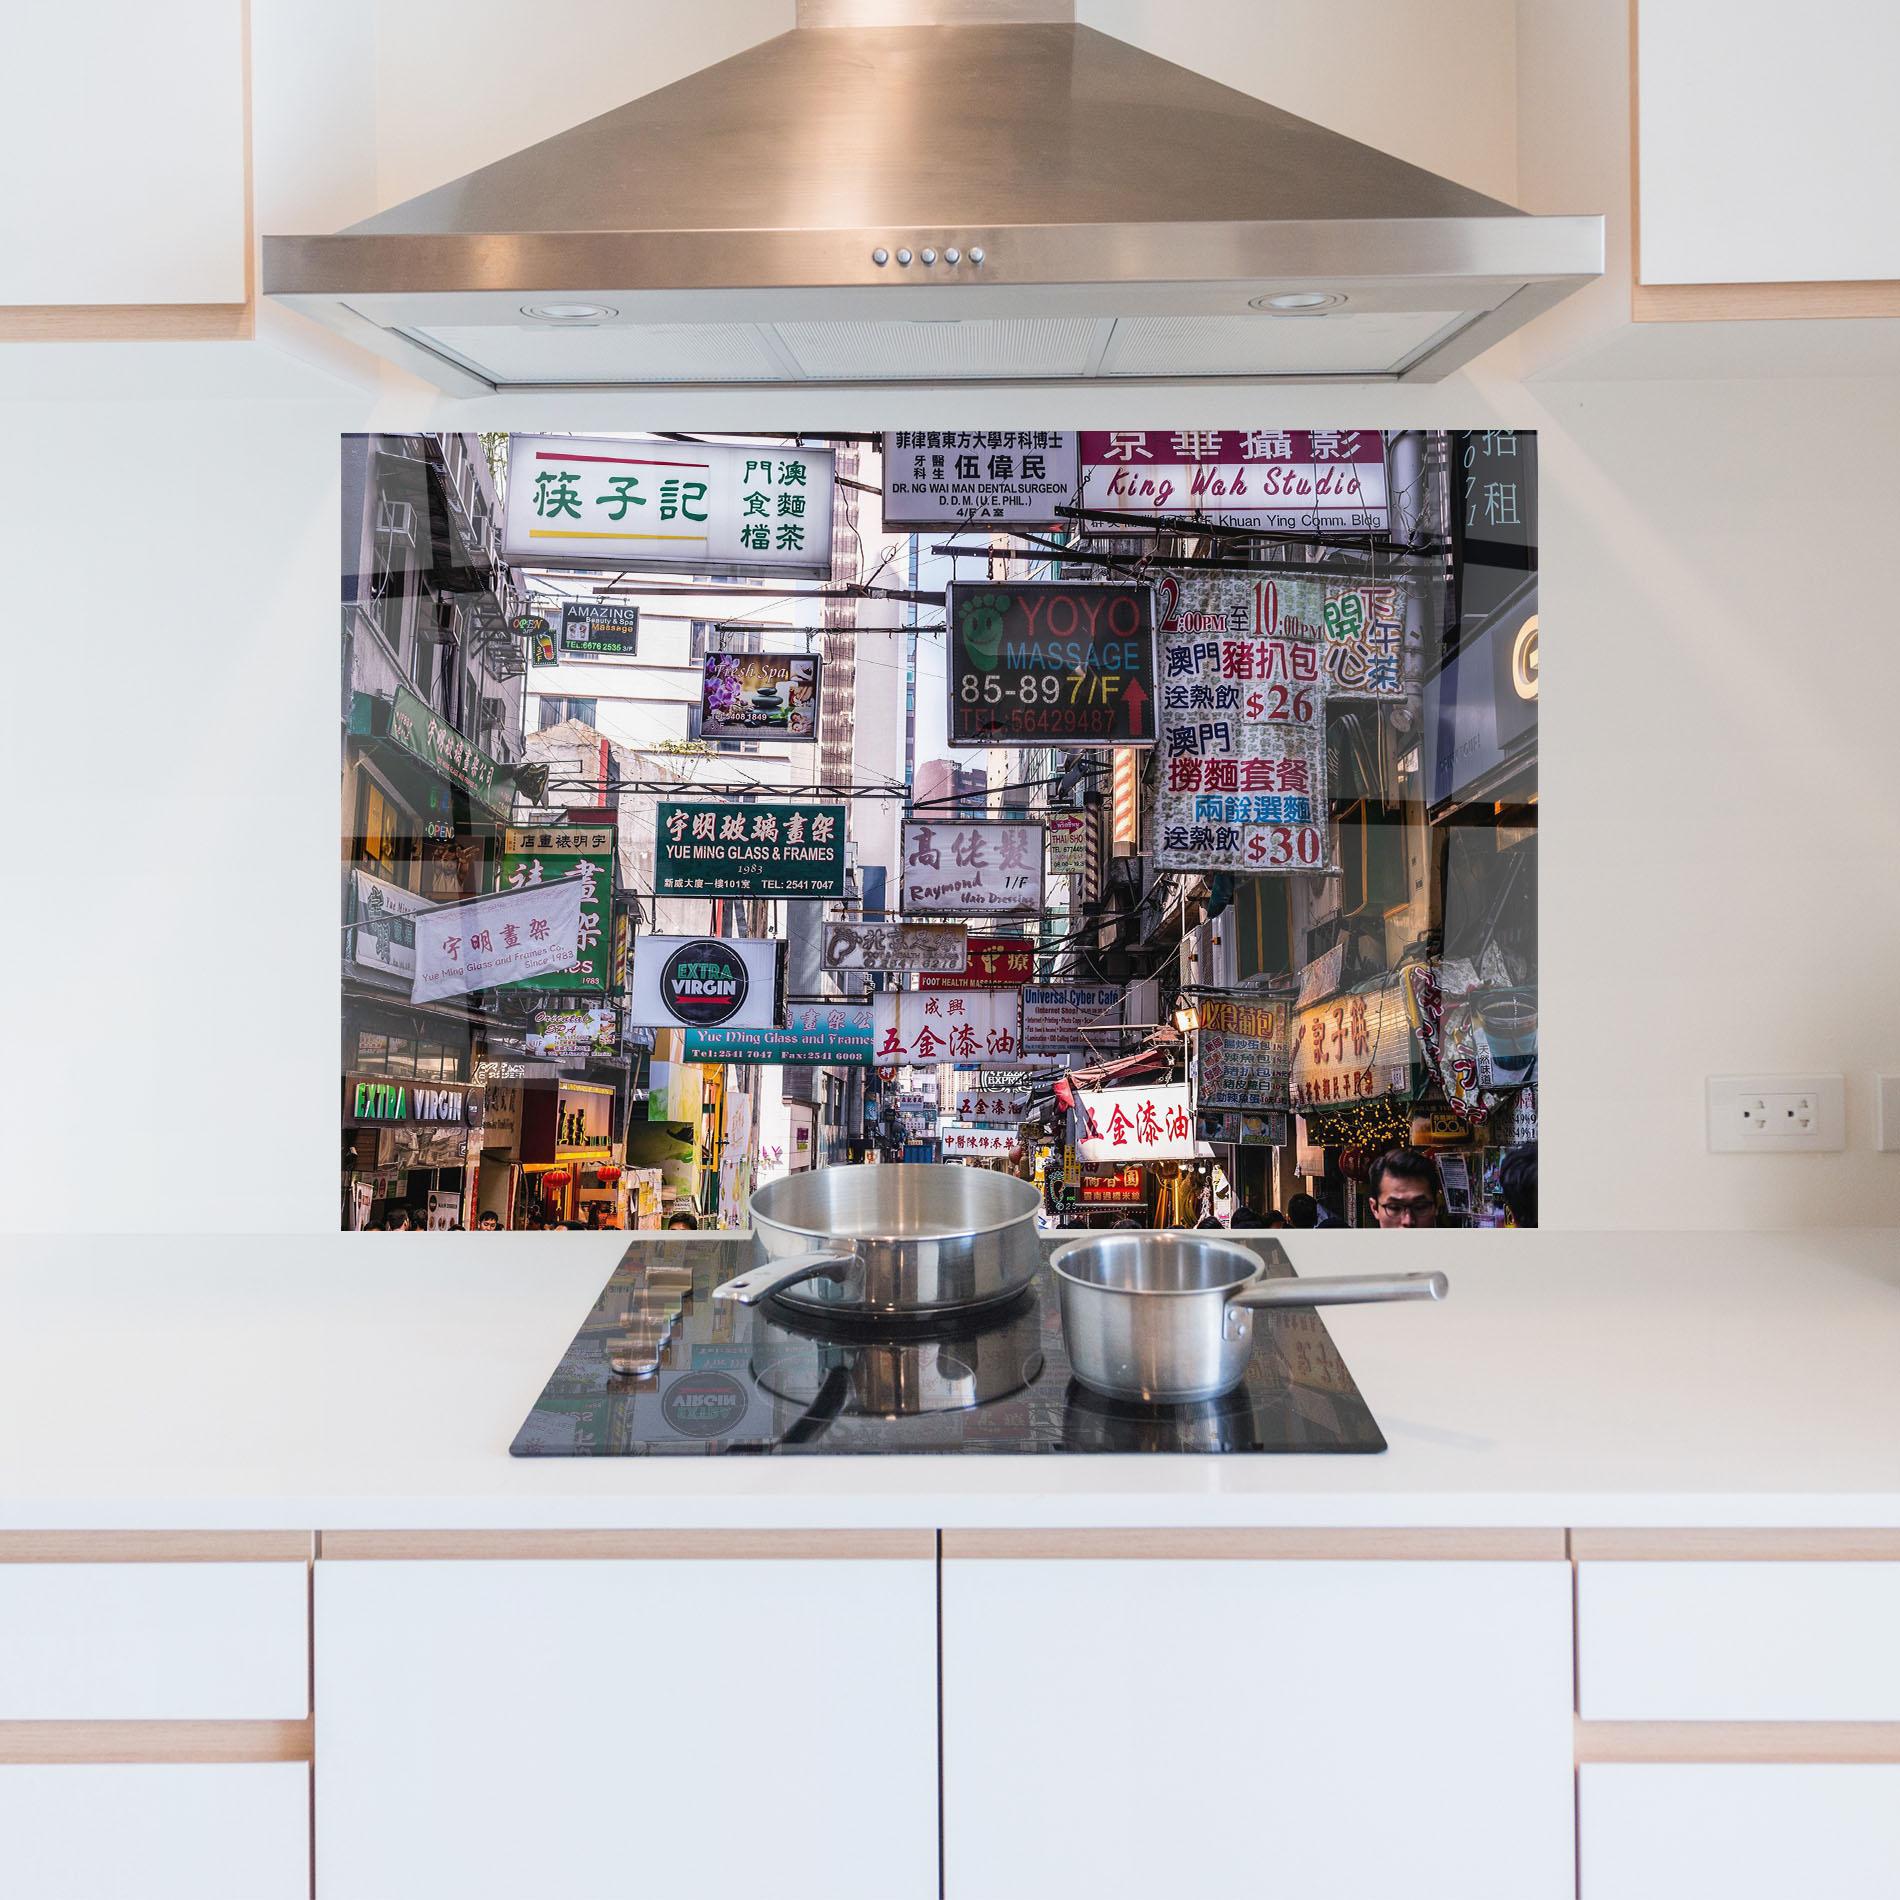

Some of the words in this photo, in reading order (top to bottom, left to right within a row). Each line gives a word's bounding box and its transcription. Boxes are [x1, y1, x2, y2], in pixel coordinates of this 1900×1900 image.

[955, 455, 1047, 480] 伍偉民
[1107, 467, 1176, 507] King
[1190, 467, 1249, 497] Wah
[1263, 465, 1361, 497] Studio
[1482, 431, 1521, 526] 招租
[892, 483, 909, 493] DR.
[911, 483, 927, 493] NG
[929, 483, 949, 493] WAI
[951, 483, 974, 493] MAN
[532, 471, 709, 523] 筷子記
[1219, 514, 1262, 528] Khuan
[1266, 515, 1296, 529] Ying
[1300, 514, 1347, 527] Comm.
[1351, 514, 1381, 529] Bldg
[567, 606, 635, 619] AMAZING
[1016, 595, 1141, 637] YOYO
[513, 618, 543, 629] OPEN
[586, 616, 612, 626] Beauty
[619, 618, 634, 627] Spa
[591, 623, 633, 634] Massage
[1007, 642, 1141, 671] MASSAGE
[1166, 642, 1319, 682] 澳門豬扒包
[714, 662, 756, 679] Fresh
[757, 664, 787, 684] Spa
[960, 674, 1061, 704] 85-89
[1066, 676, 1121, 704] 7/F
[1164, 686, 1239, 710] 送熱飲
[1246, 684, 1313, 723] $26
[1166, 723, 1231, 758] 澳門
[1052, 835, 1067, 843] THAI
[1069, 834, 1084, 843] SHO
[1163, 826, 1239, 852] 送熱飲
[1248, 828, 1320, 864] $30
[666, 845, 691, 859] YUE
[728, 847, 770, 861] GLASS
[773, 848, 781, 860] &
[784, 847, 834, 861] FRAMES
[738, 864, 764, 875] 1983
[762, 880, 784, 889] TEL:
[786, 880, 809, 890] 2541
[811, 881, 834, 890] 7047
[909, 871, 983, 901] Raymond
[1004, 877, 1029, 889] 1/F
[421, 971, 441, 983] Yue
[441, 966, 465, 979] Ming
[466, 960, 493, 973] Glass
[495, 956, 513, 968] and
[514, 949, 548, 965] Frames
[549, 943, 565, 954] Co.
[525, 957, 550, 971] Since
[550, 951, 575, 964] 1983
[677, 963, 734, 980] EXTRA
[582, 977, 600, 985] 1983
[671, 979, 737, 996] VIRGIN
[922, 977, 940, 986] FOOT
[941, 978, 968, 987] HEALTH
[1025, 989, 1067, 1004] Universal
[1069, 990, 1095, 1006] Cyber
[1098, 989, 1119, 1005] Café
[698, 1031, 722, 1043] Yue
[726, 1031, 761, 1045] Ming
[764, 1032, 799, 1044] Glass
[802, 1032, 824, 1045] and
[828, 1033, 874, 1046] Frames
[876, 1022, 1014, 1059] 五金漆油
[747, 1050, 773, 1059] 7047
[354, 1083, 407, 1121] EXTRA
[413, 1087, 464, 1121] VIRGIN
